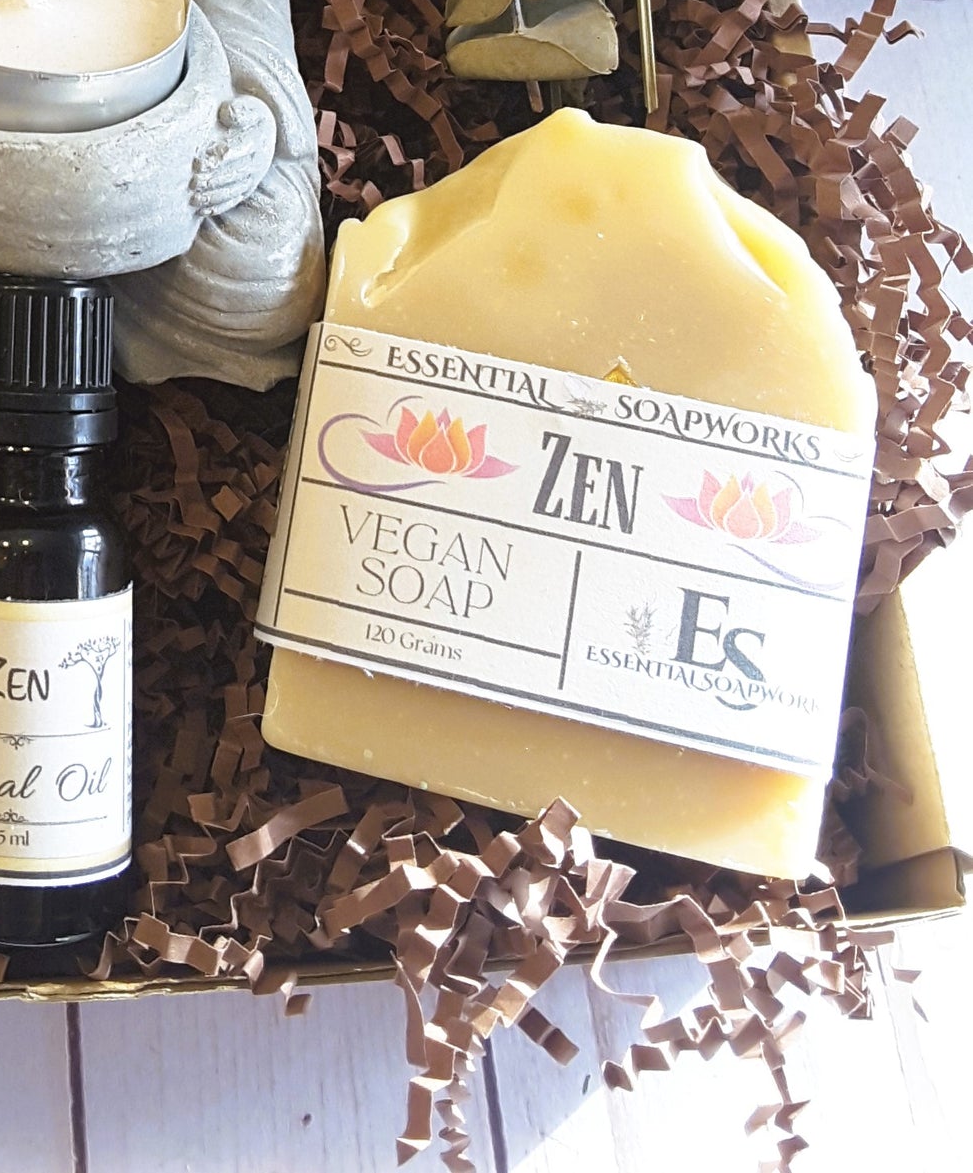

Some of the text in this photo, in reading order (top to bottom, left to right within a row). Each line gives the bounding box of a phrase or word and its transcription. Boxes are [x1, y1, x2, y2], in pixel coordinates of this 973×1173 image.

[386, 345, 820, 462] ESSENTIAL SOAPWORKS
[532, 430, 643, 534] ZEN
[340, 504, 513, 580] VEGAN
[355, 557, 494, 619] SOAP
[365, 624, 462, 662] 120 Grams
[56, 757, 112, 802] Oil
